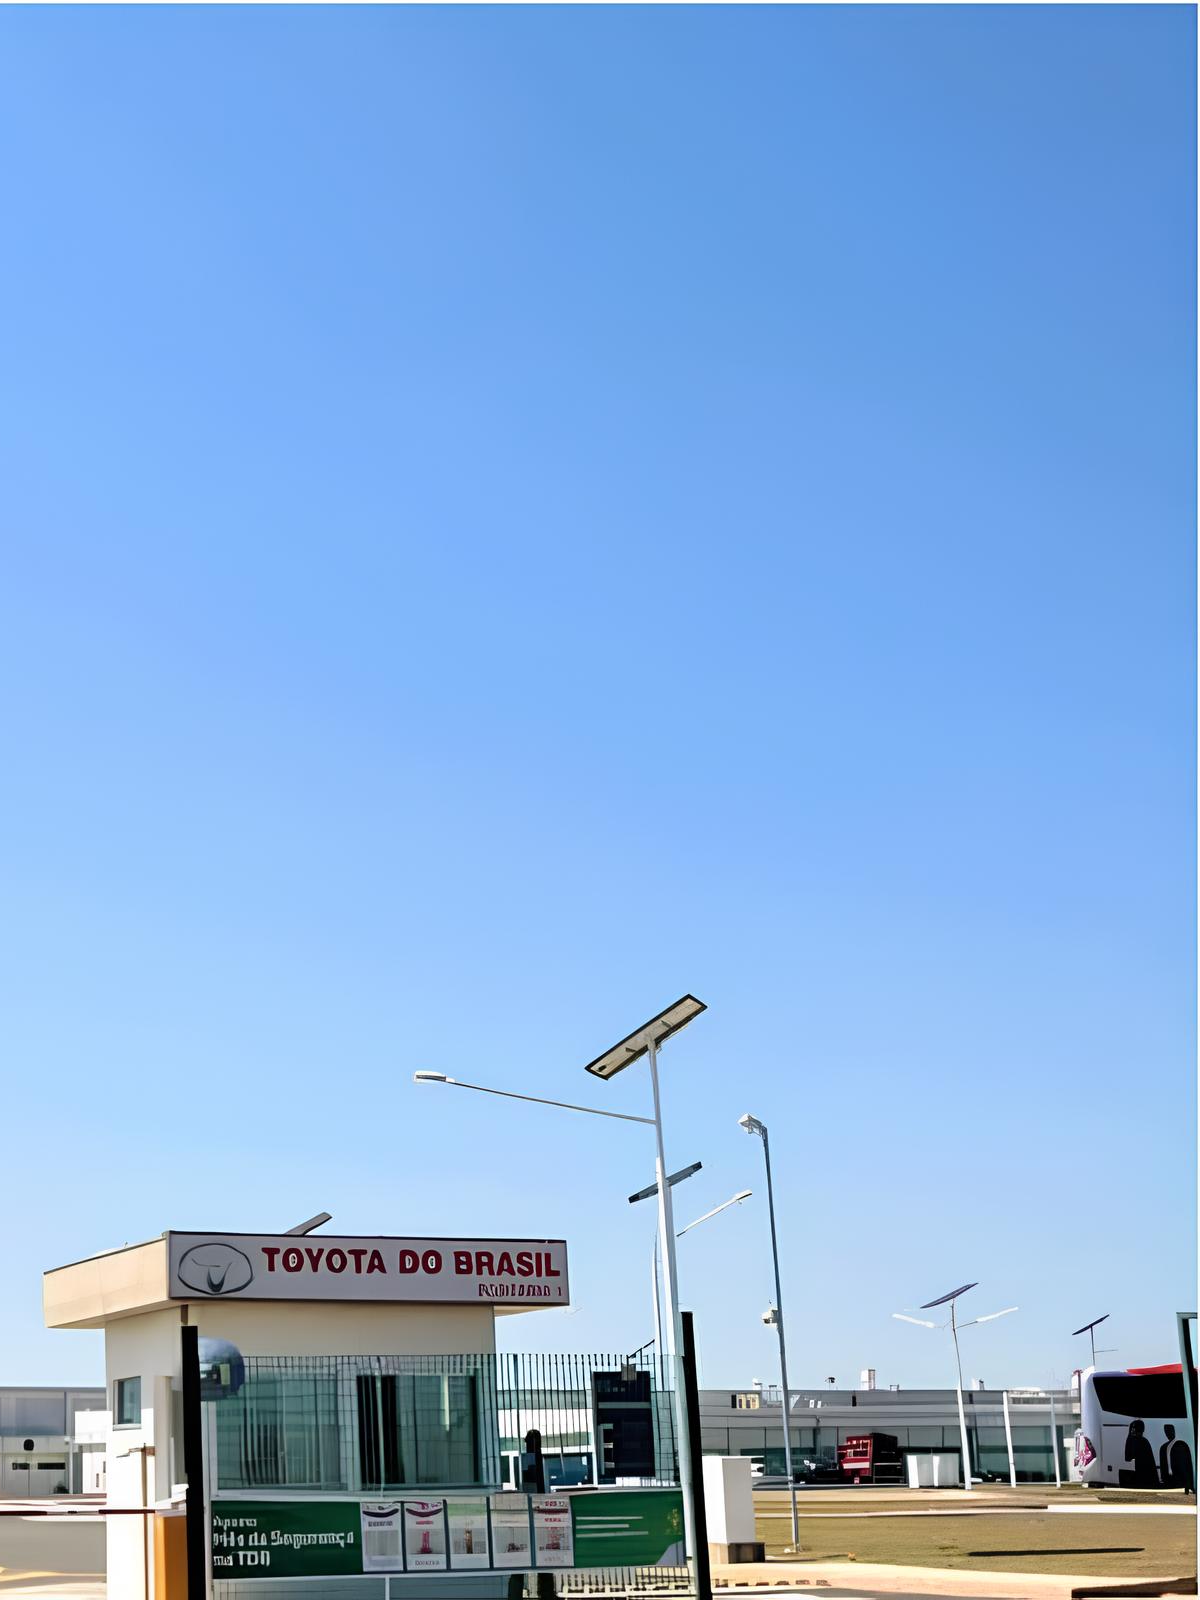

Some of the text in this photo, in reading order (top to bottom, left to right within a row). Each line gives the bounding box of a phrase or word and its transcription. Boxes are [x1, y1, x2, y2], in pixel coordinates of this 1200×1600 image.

[261, 1247, 561, 1278] TOYOTA DO BRASIL
